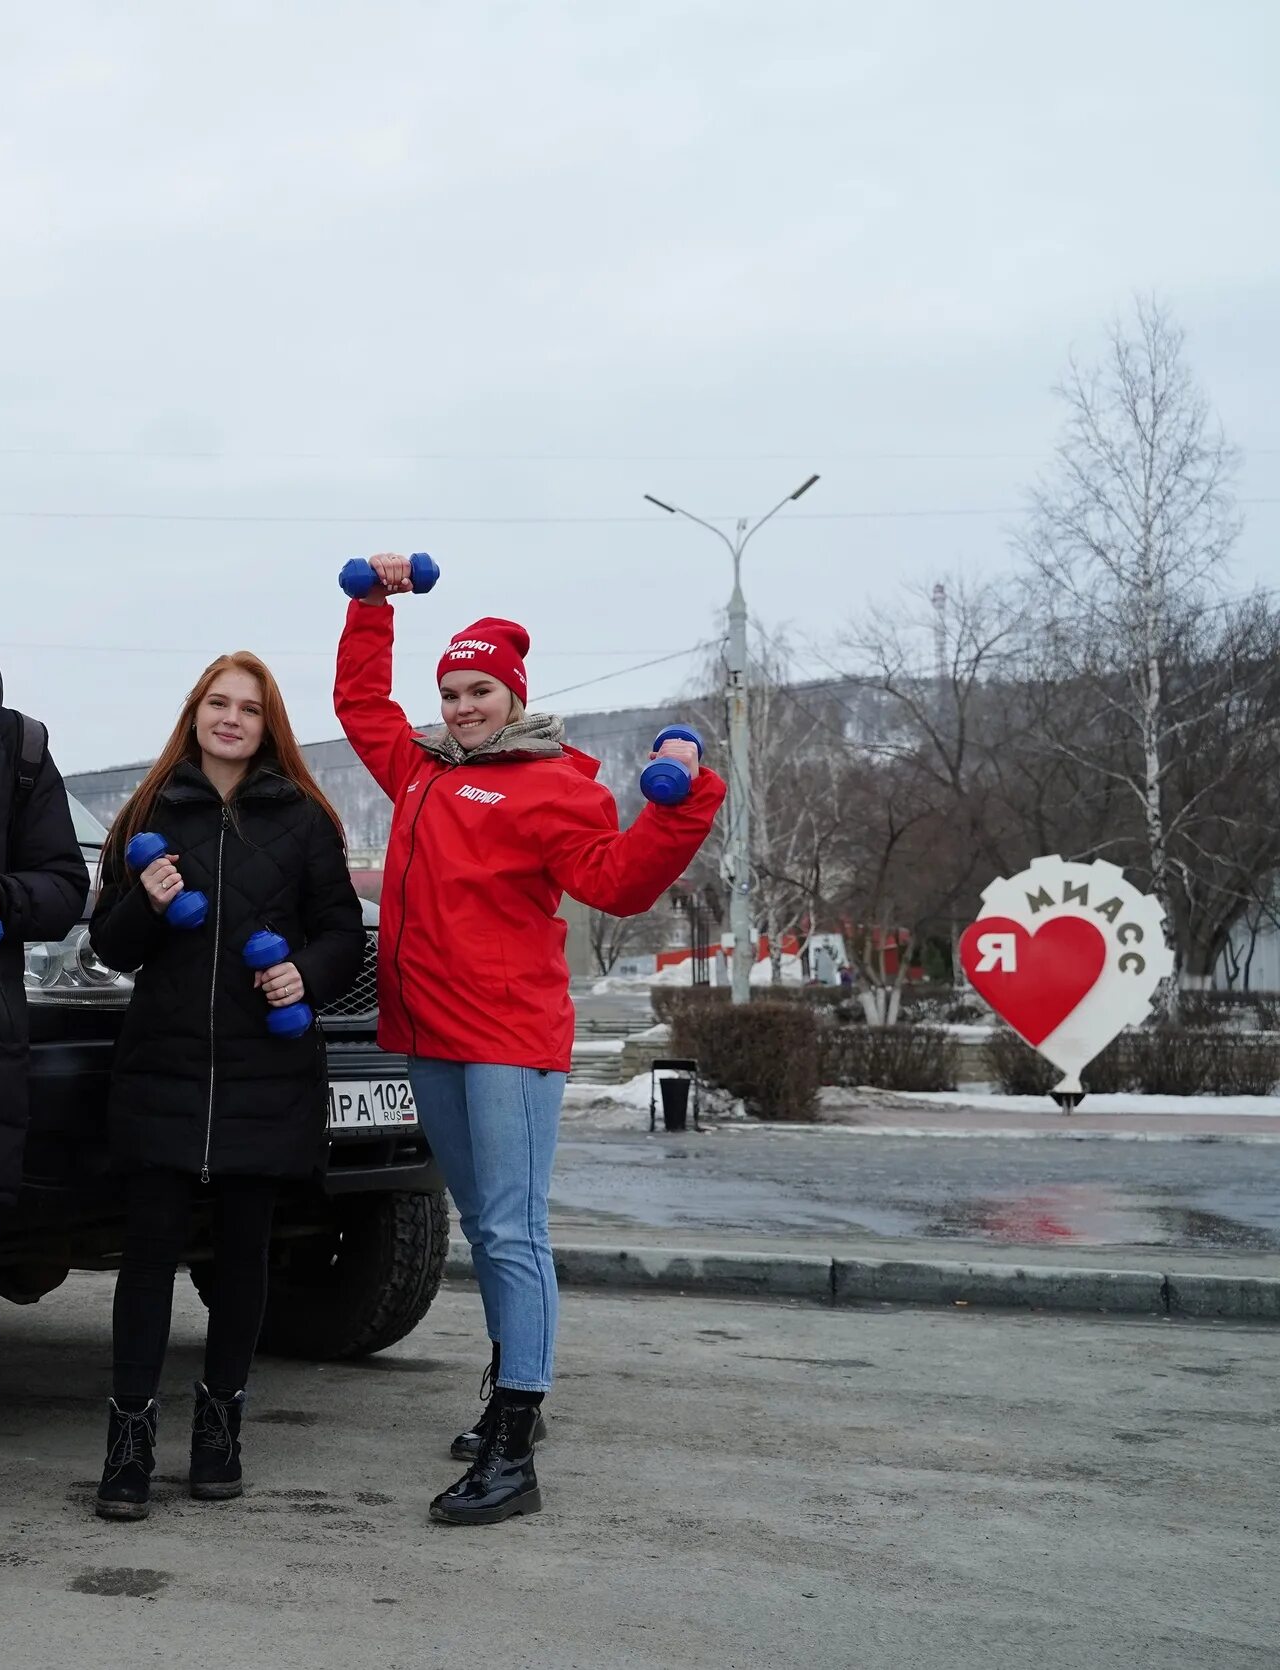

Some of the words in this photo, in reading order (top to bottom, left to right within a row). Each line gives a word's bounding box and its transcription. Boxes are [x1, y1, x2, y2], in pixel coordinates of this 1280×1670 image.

[450, 650, 475, 660] ТНТ
[455, 784, 506, 804] ПАТРИОТ
[1024, 880, 1146, 976] МИАСС
[975, 933, 1018, 973] Я
[374, 1083, 410, 1110] 102
[384, 1111, 402, 1120] RUS
